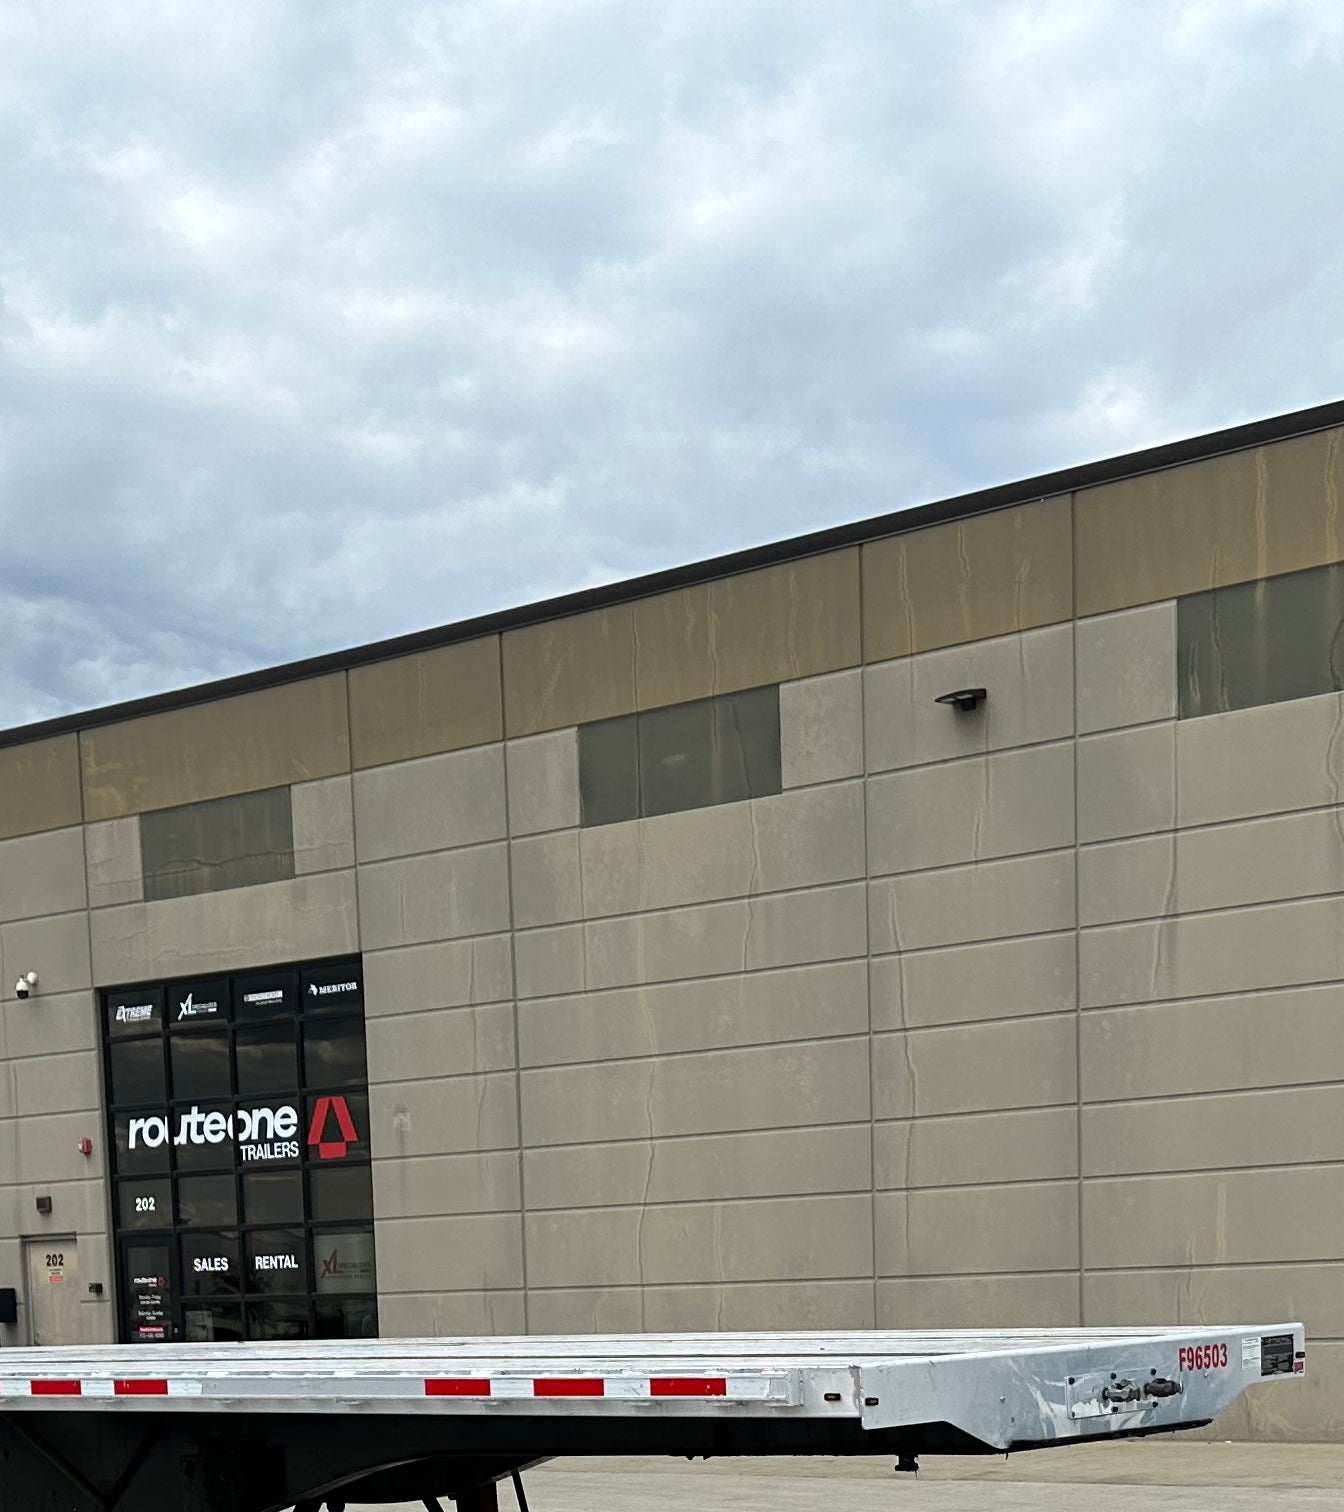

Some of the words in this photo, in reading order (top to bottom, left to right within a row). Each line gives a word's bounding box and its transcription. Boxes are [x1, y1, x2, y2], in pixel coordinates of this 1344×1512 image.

[128, 1105, 298, 1149] routeone
[240, 1142, 299, 1161] TRAILERS
[135, 1197, 155, 1211] 202
[46, 1253, 64, 1267] 202
[193, 1257, 229, 1272] SALES
[254, 1254, 299, 1270] RENTAL
[1178, 1343, 1228, 1372] F96503
